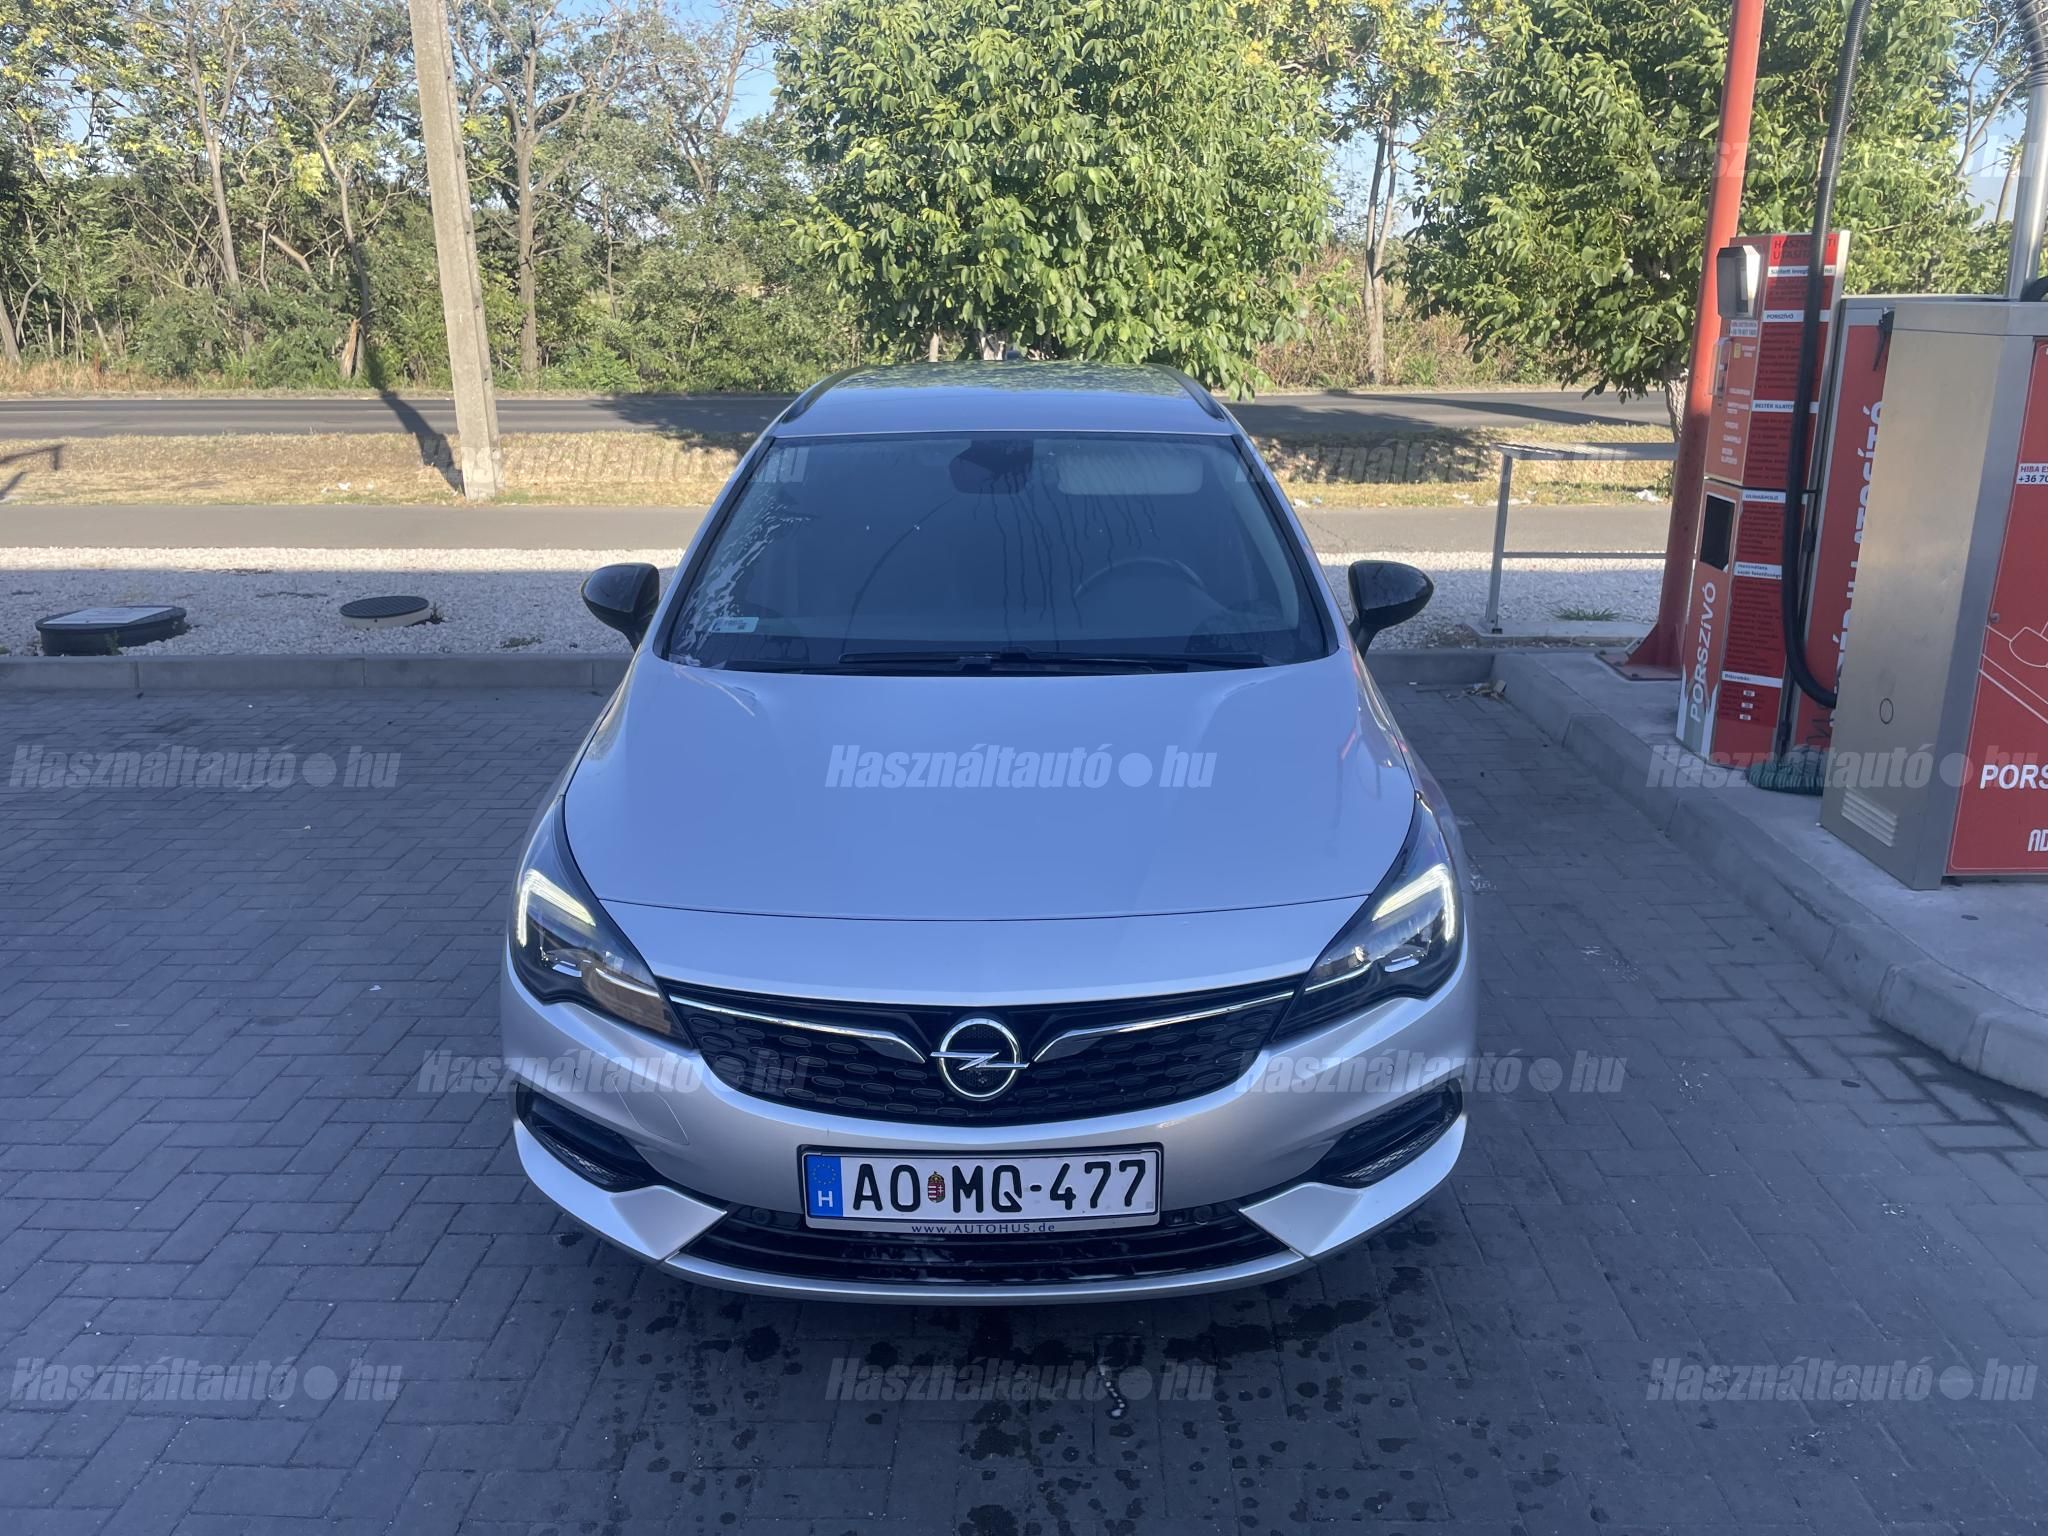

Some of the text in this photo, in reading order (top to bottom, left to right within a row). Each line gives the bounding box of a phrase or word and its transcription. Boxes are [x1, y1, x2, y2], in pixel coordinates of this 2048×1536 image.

[1774, 239, 1836, 249] HASZNTI
[2020, 465, 2040, 473] HIBA
[1690, 581, 1716, 723] PORSZÍVÓ
[817, 1190, 834, 1208] H
[911, 1222, 1055, 1235] www.AUTOHUS.de
